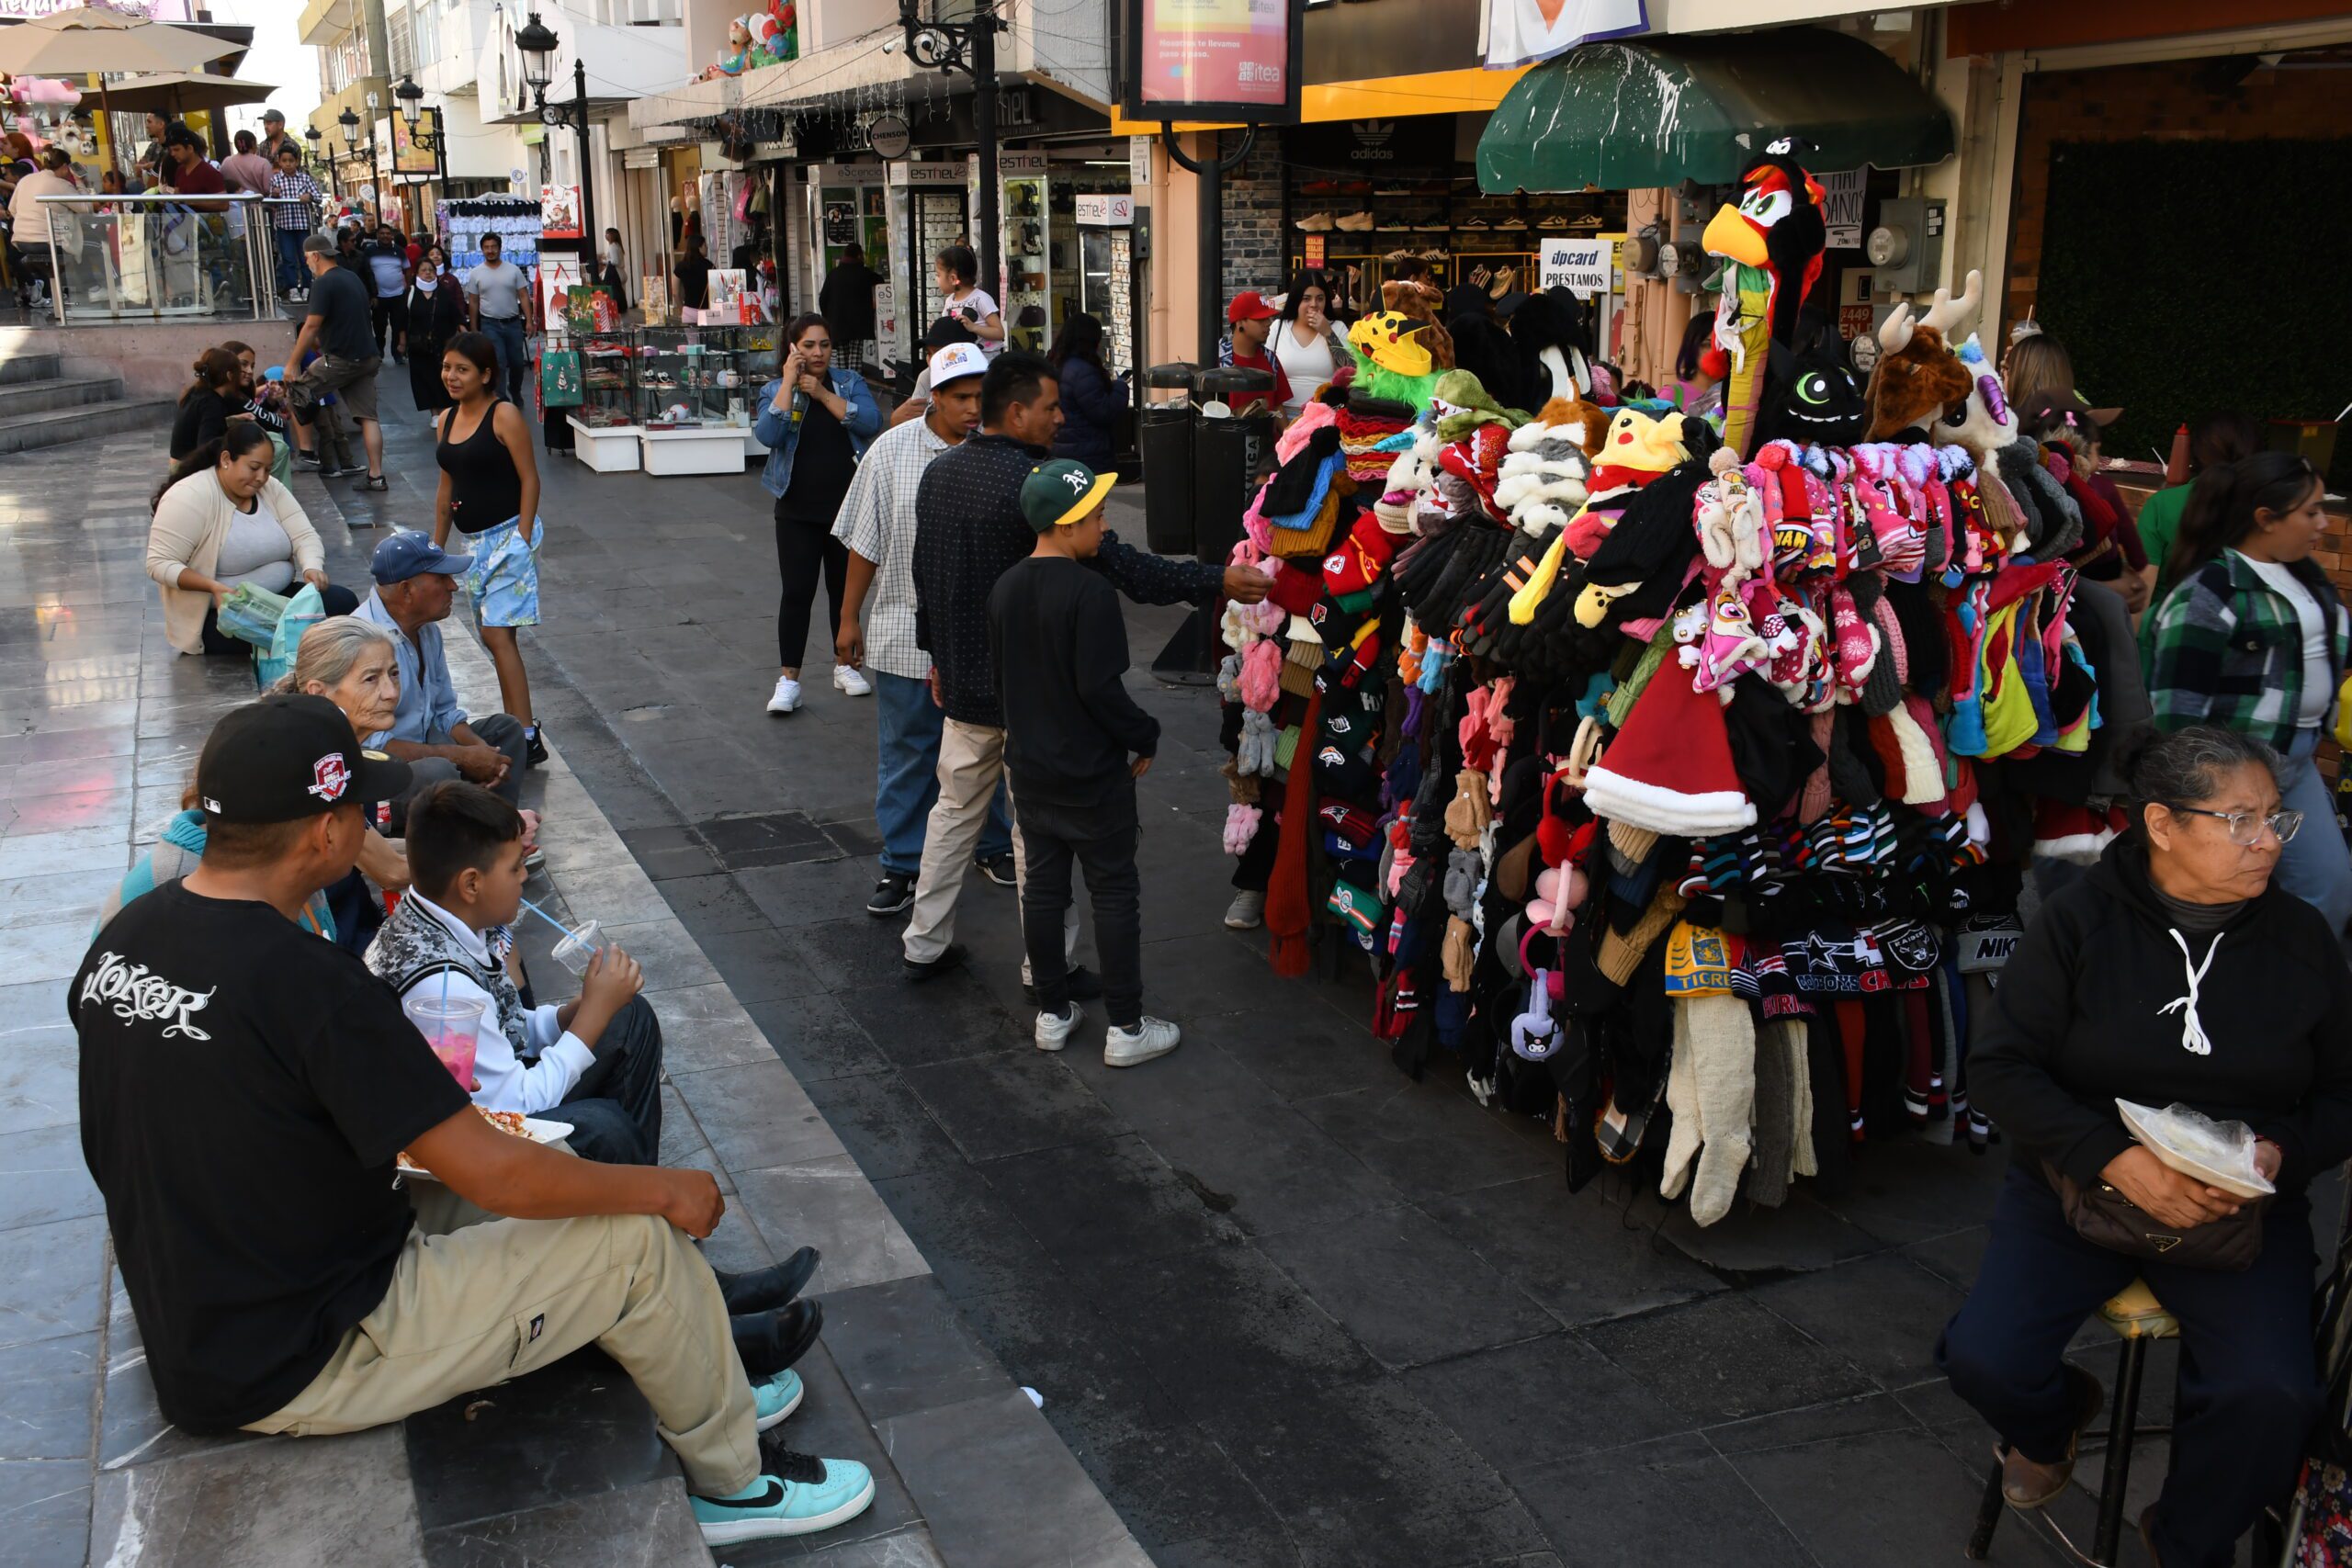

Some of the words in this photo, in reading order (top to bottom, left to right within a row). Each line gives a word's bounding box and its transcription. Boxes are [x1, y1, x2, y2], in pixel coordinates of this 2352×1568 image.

[1208, 39, 1240, 49] llevamos
[1254, 62, 1280, 82] itea
[872, 130, 908, 141] CHENSON
[1351, 147, 1394, 160] adidas
[1551, 250, 1599, 266] dpcard
[1545, 273, 1603, 287] PRESTAMOS
[1950, 900, 1968, 908] PUMA
[1894, 929, 1928, 947] RAIDERS
[1973, 937, 2019, 960] NIK
[1679, 971, 1732, 989] TIGRE
